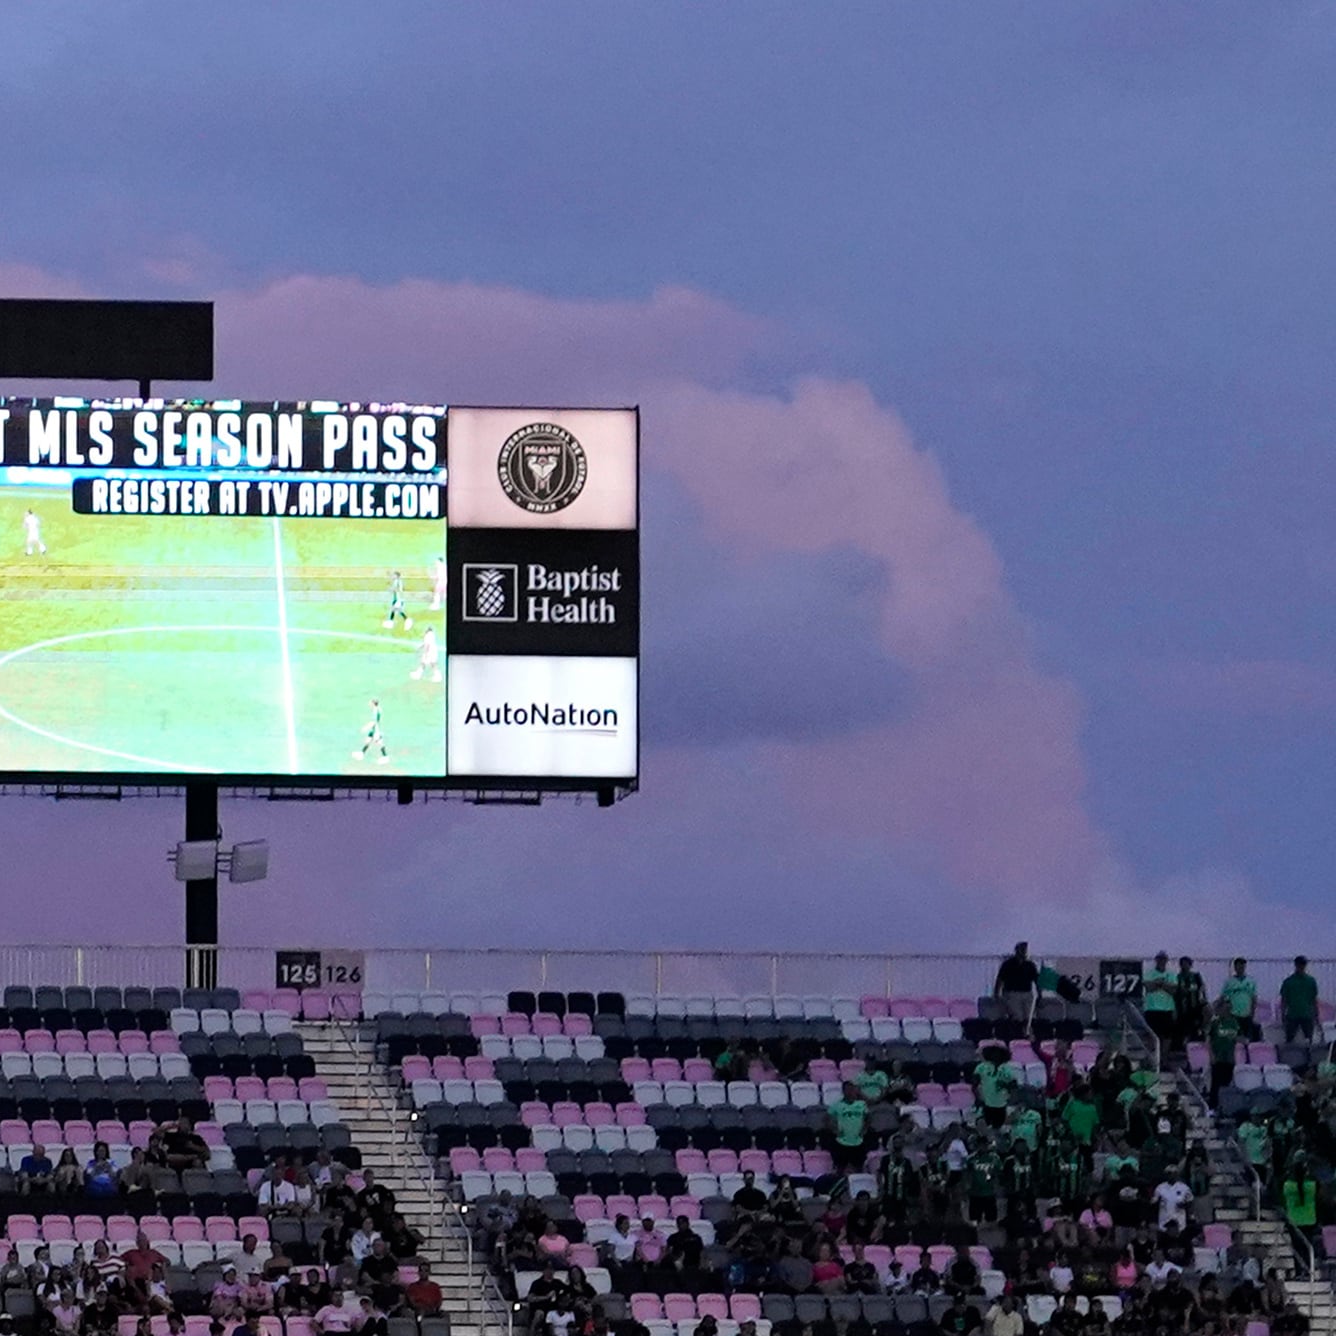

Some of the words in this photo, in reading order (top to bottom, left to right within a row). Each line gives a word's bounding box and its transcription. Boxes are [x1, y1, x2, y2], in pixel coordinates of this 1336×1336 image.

[29, 409, 116, 466] MLS
[133, 411, 304, 470] SEASON
[322, 413, 437, 472] PASS
[92, 480, 211, 514] REGISTER
[219, 482, 250, 515] AT
[257, 482, 440, 518] TV.APPLE.COM
[526, 563, 623, 598] Baptist
[526, 596, 616, 624] Health
[464, 701, 619, 727] AutoNation
[281, 964, 318, 985] 125
[326, 965, 362, 984] 126
[1105, 974, 1140, 993] 127
